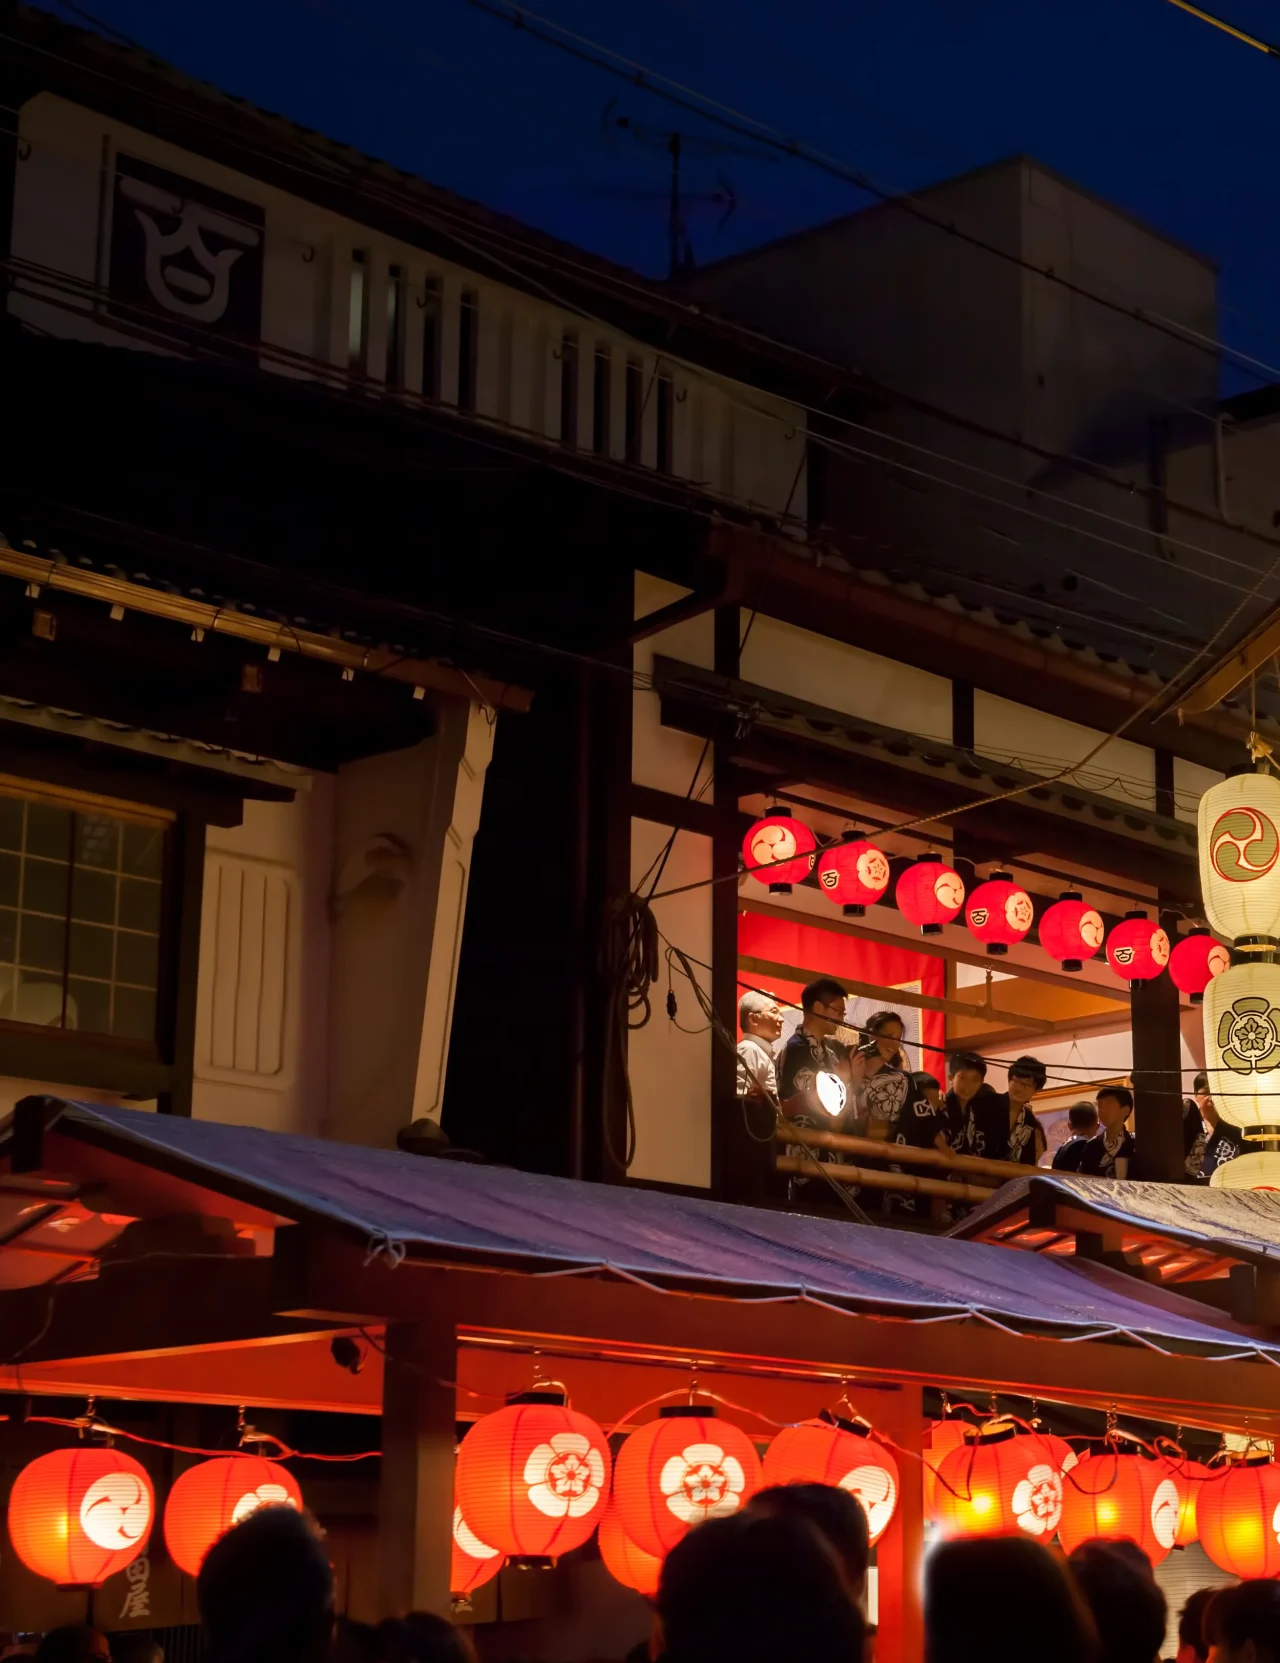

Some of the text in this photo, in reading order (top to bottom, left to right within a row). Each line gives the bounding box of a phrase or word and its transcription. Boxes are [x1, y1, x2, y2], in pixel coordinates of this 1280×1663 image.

[822, 871, 838, 888] 百
[971, 909, 988, 926] 百
[1114, 948, 1134, 964] 百
